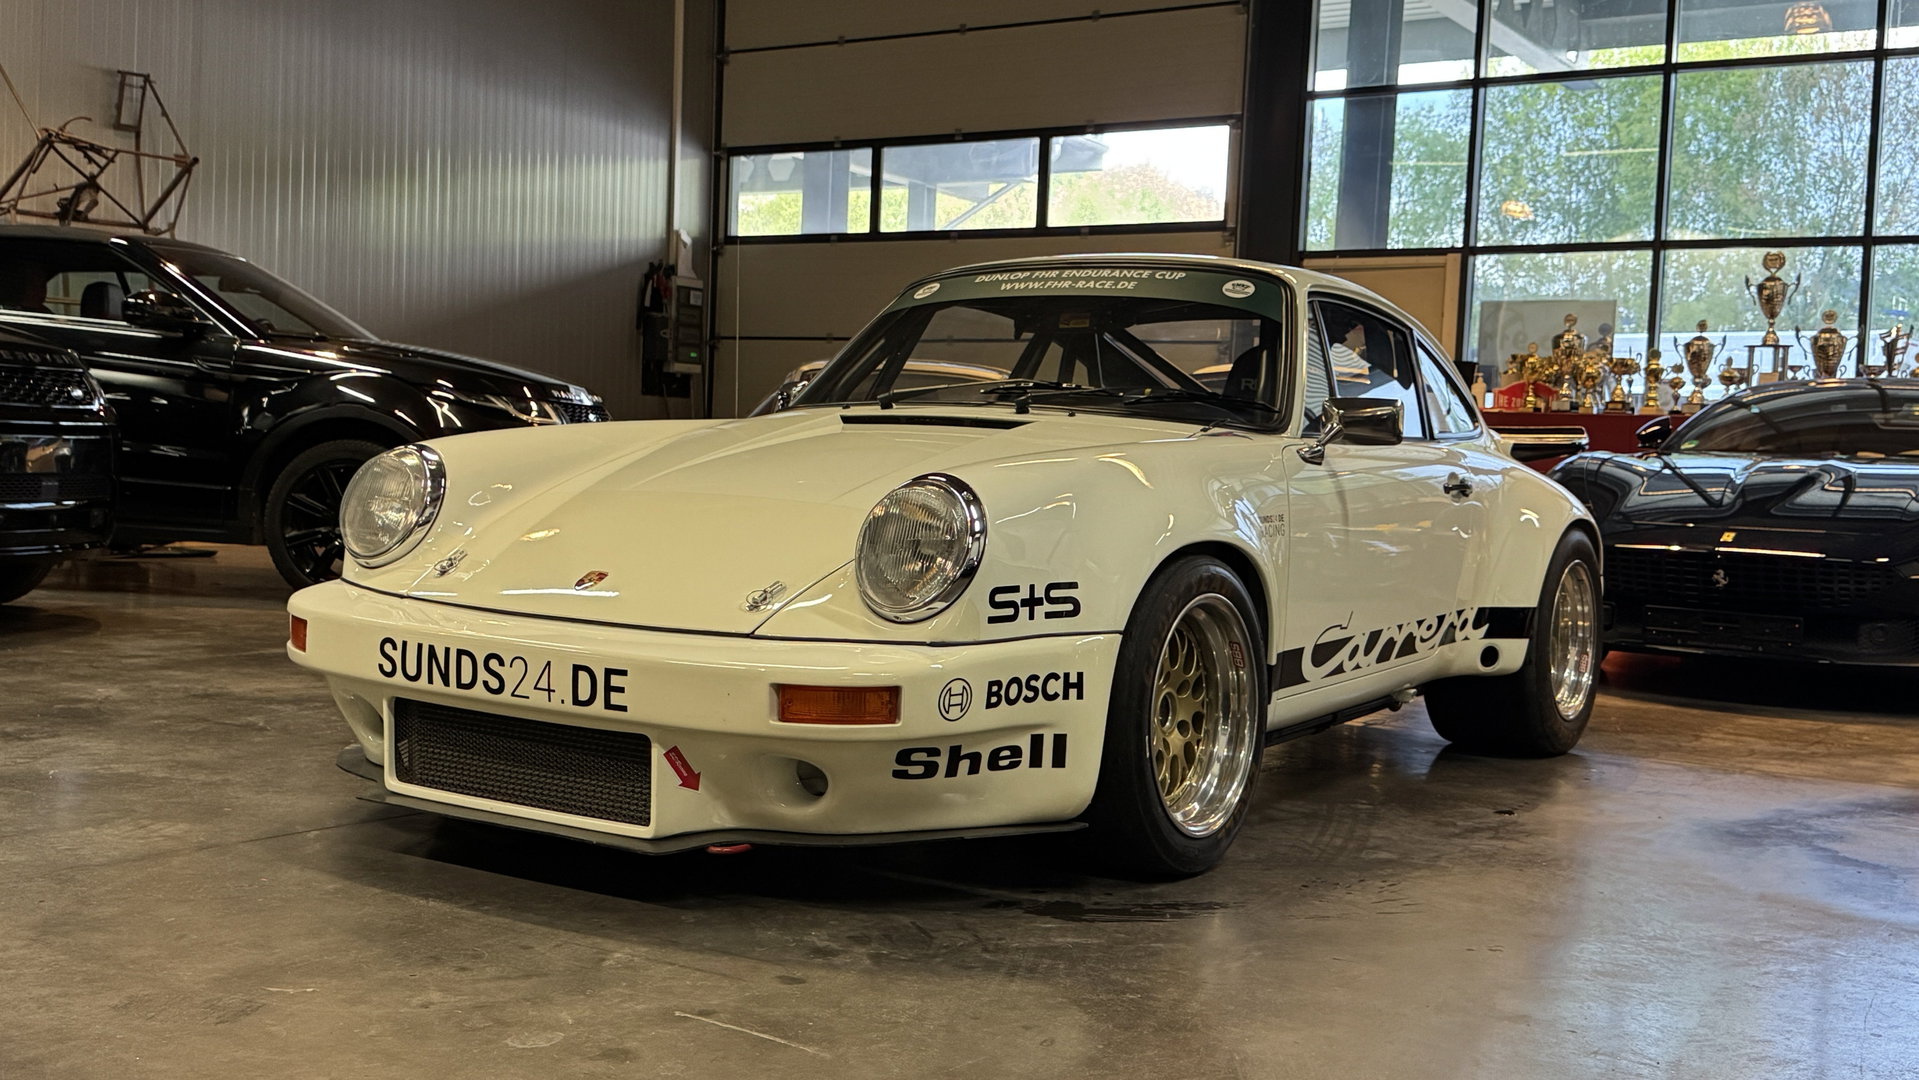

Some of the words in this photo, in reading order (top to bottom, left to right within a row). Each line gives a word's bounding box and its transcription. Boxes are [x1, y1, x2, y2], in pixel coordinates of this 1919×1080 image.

[974, 272, 1030, 283] DUNLOP
[1032, 271, 1059, 279] FHR
[1061, 269, 1152, 279] ENDURANCE
[1154, 271, 1186, 280] CUP
[1000, 280, 1138, 291] WWW.FHR-RACE.DE
[987, 582, 1081, 624] S+S
[1232, 642, 1244, 668] BBS
[1302, 610, 1489, 682] Carrera
[378, 636, 628, 712] SUNDS24.DE
[985, 671, 1084, 710] BOSCH
[891, 733, 1068, 780] Shell
